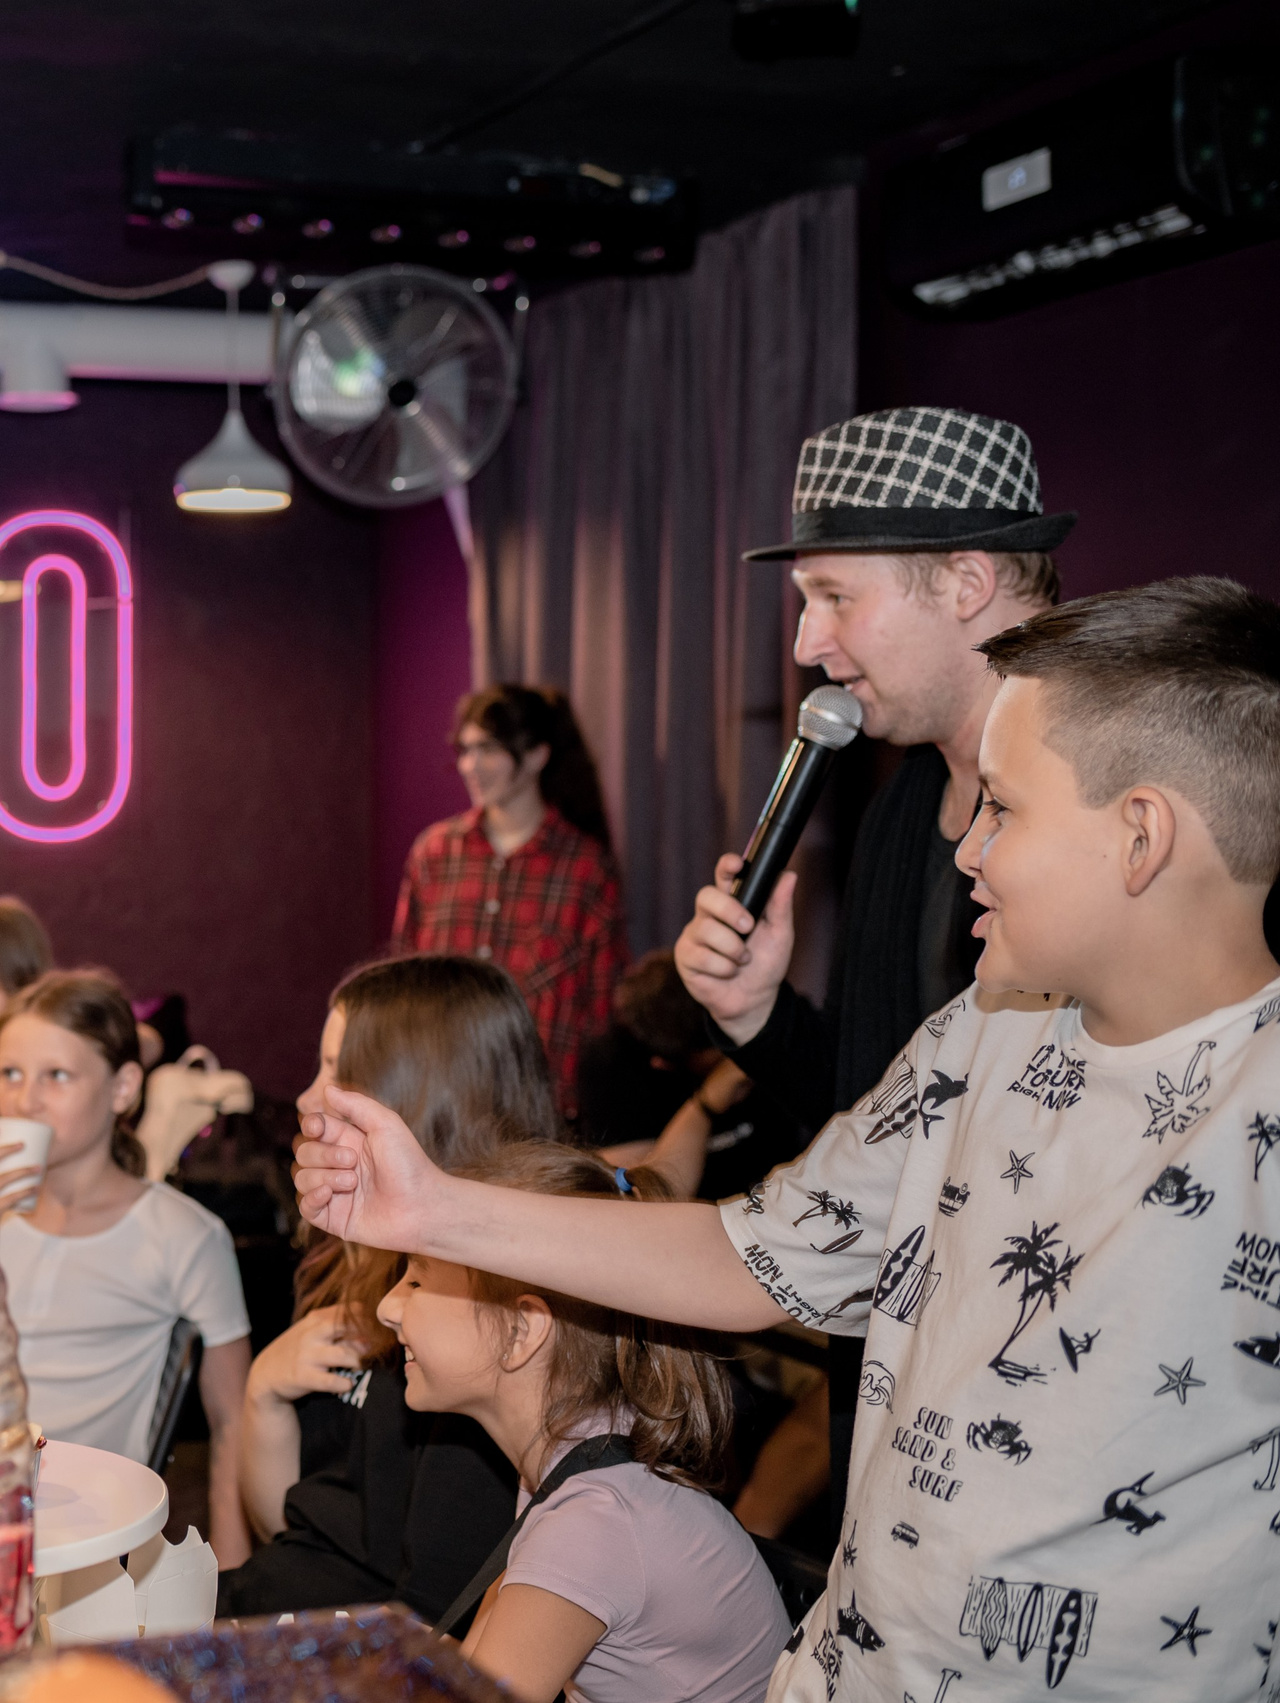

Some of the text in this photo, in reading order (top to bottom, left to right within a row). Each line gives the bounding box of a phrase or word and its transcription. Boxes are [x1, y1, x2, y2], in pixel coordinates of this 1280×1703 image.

[913, 1406, 954, 1440] SUN
[891, 1426, 957, 1472] SAND &
[908, 1464, 964, 1502] SURF
